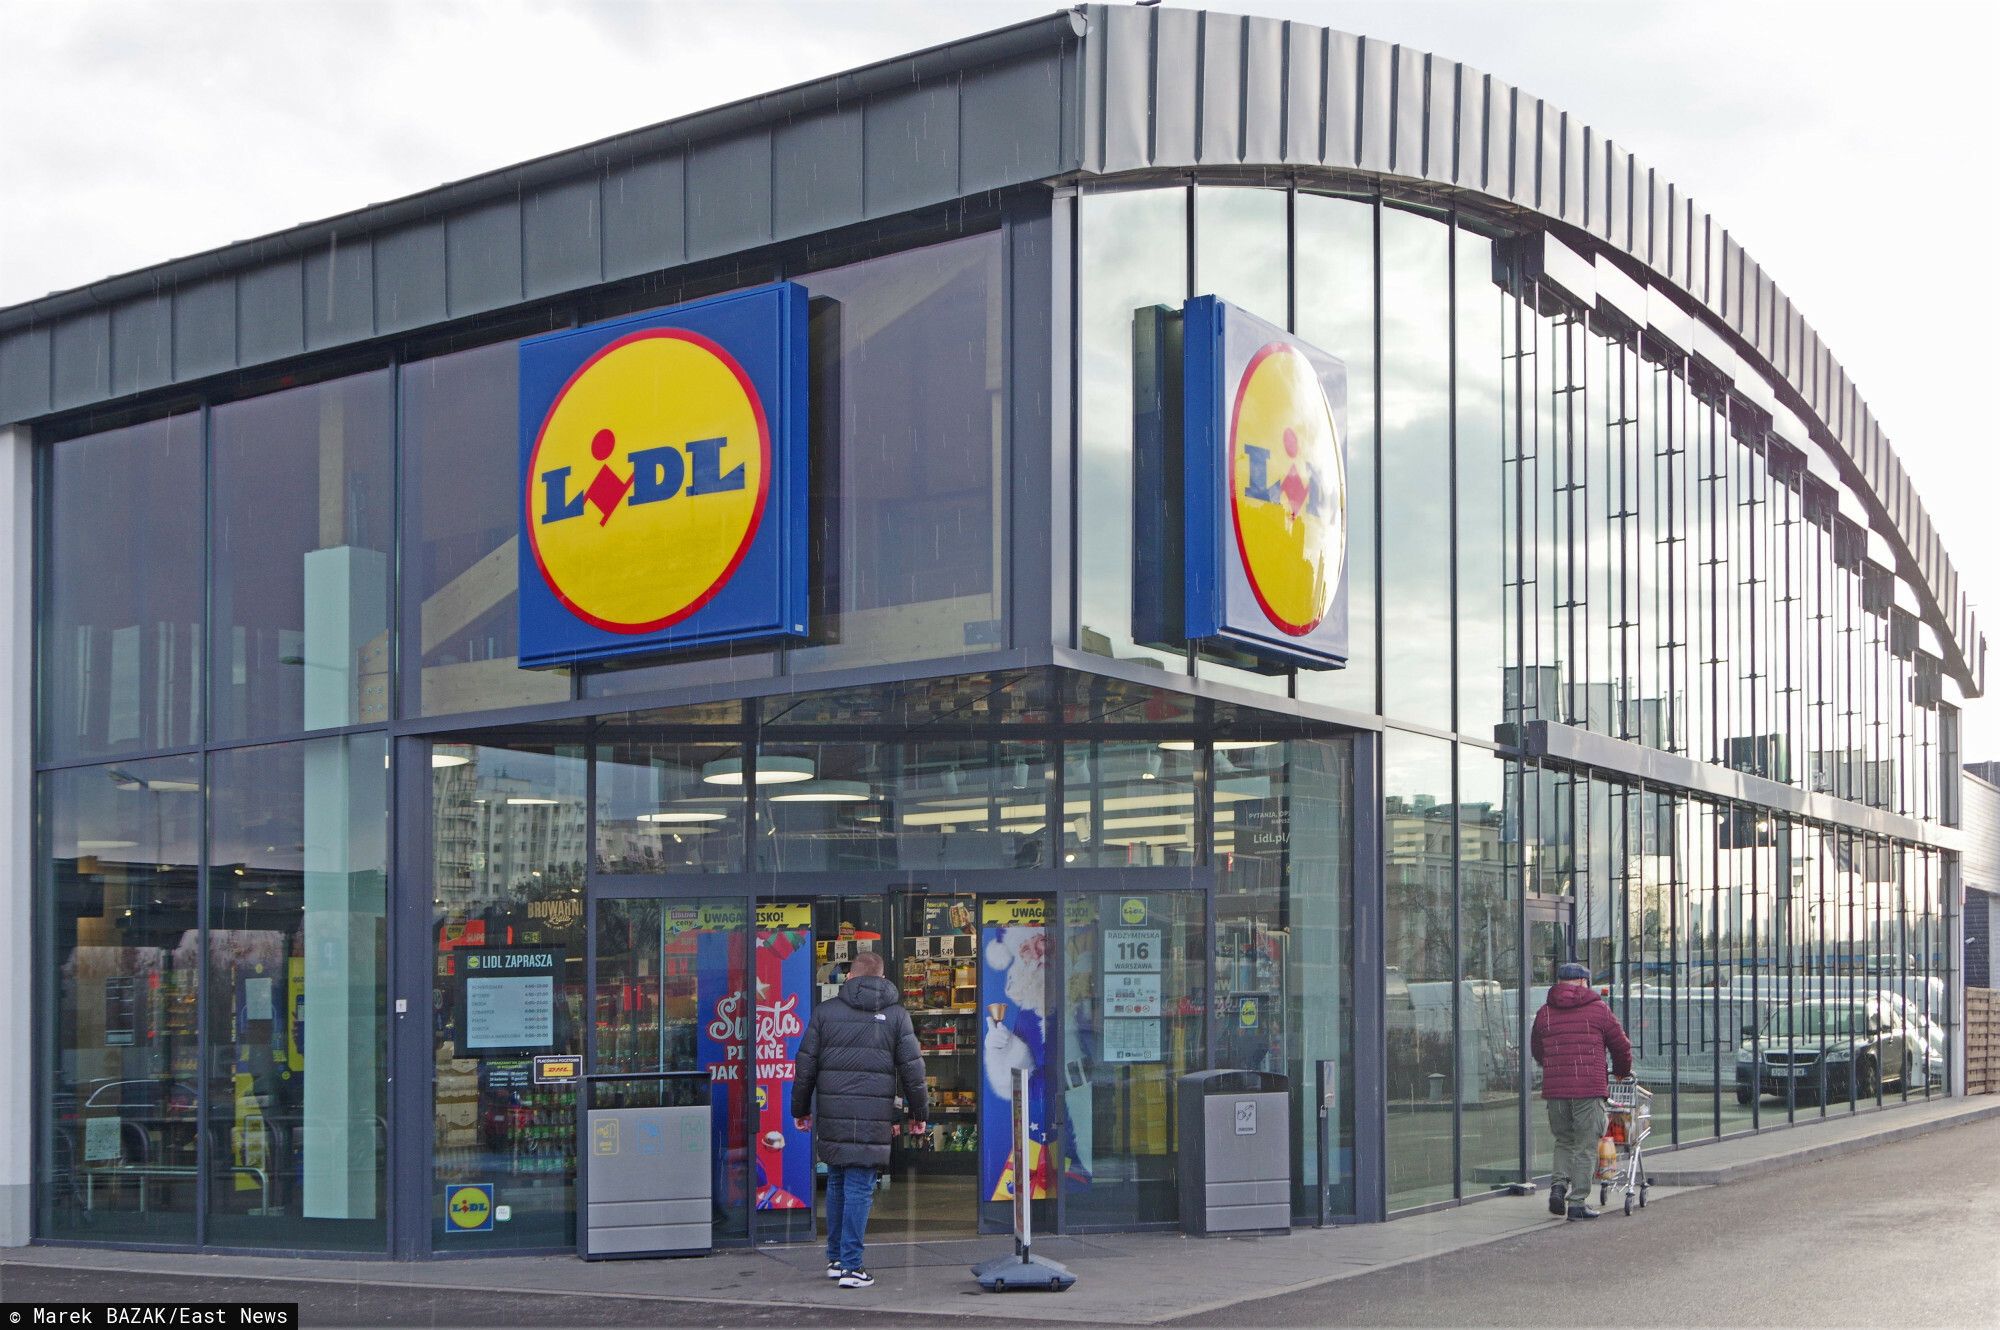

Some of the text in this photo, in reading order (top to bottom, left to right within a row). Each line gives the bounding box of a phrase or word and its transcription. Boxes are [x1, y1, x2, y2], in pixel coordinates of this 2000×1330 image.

[1117, 942, 1149, 960] 116
[482, 954, 553, 969] LIDL ZAPRASZA
[727, 1044, 784, 1060] PIKNE
[709, 1065, 739, 1080] JAK
